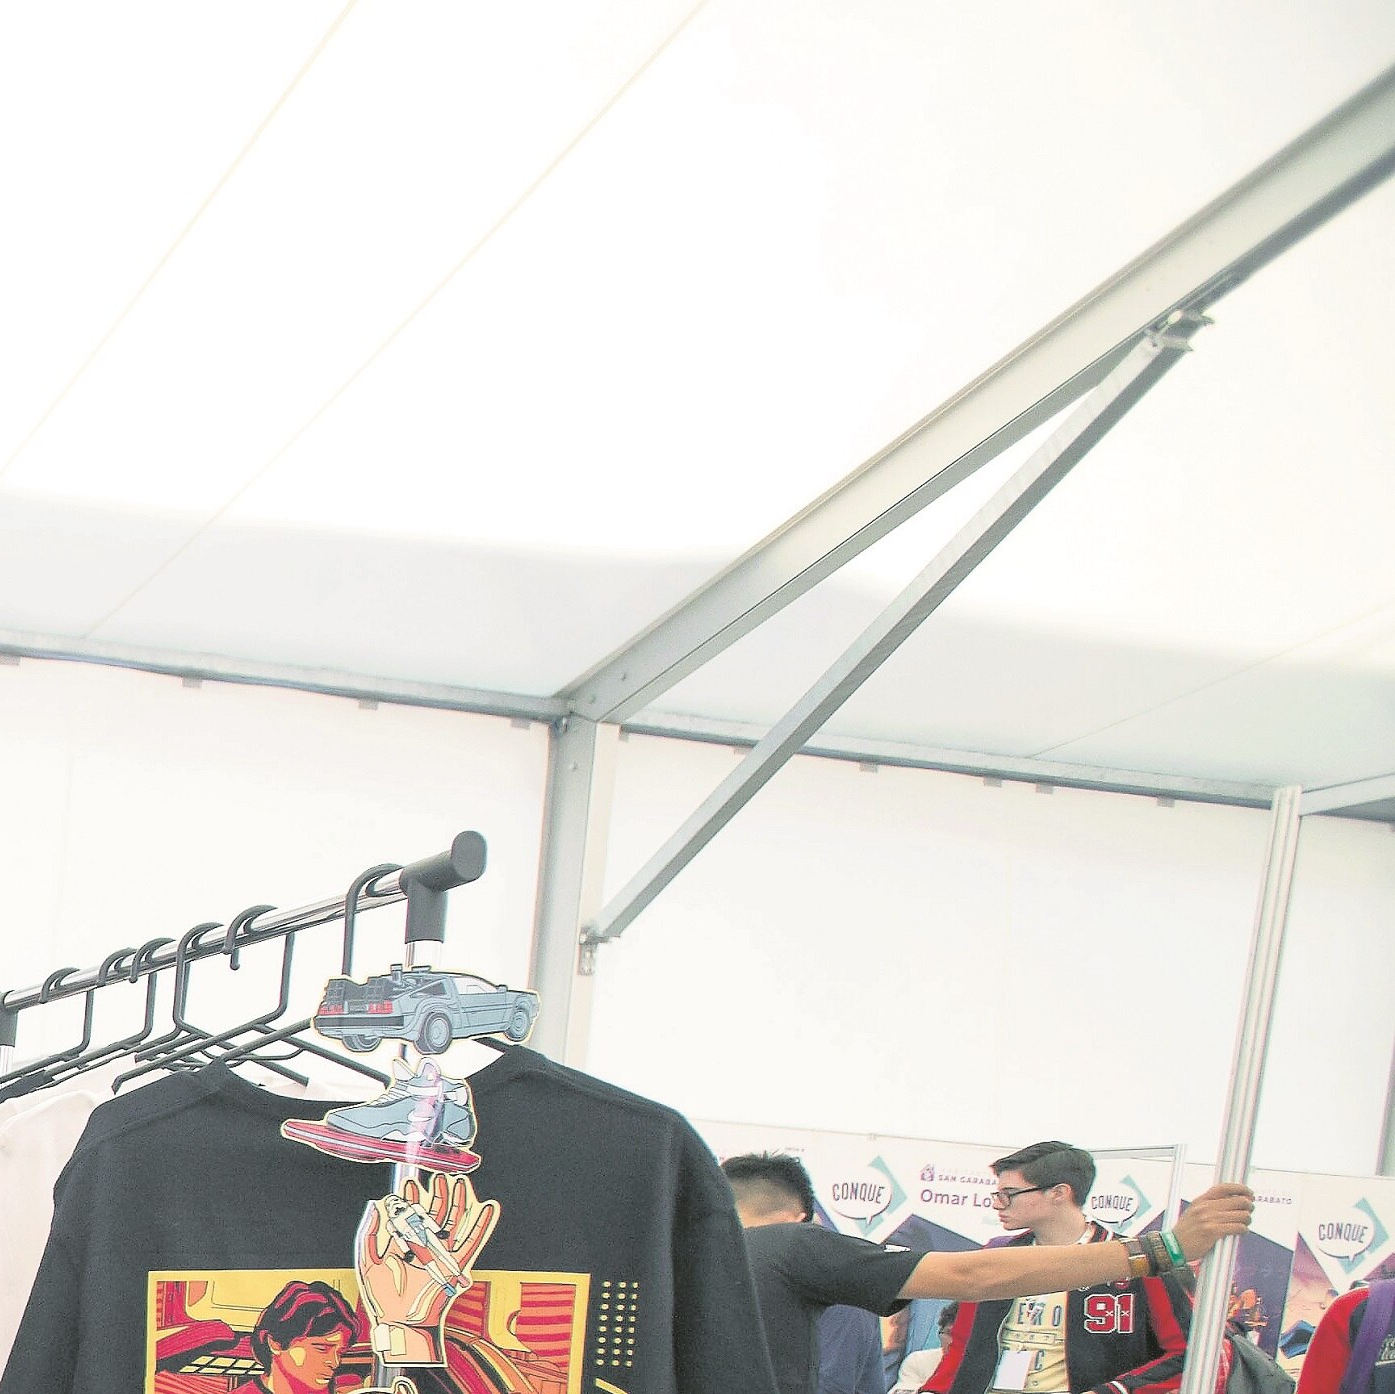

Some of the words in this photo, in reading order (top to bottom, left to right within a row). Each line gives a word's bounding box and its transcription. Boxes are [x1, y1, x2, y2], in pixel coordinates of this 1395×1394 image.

[938, 1173, 957, 1184] SAN
[832, 1181, 886, 1205] CONQUE
[920, 1188, 968, 1207] Omar
[973, 1190, 995, 1208] Lo
[1091, 1195, 1134, 1213] CONQUE
[1317, 1221, 1369, 1244] CONQUE
[1083, 1293, 1134, 1334] 91
